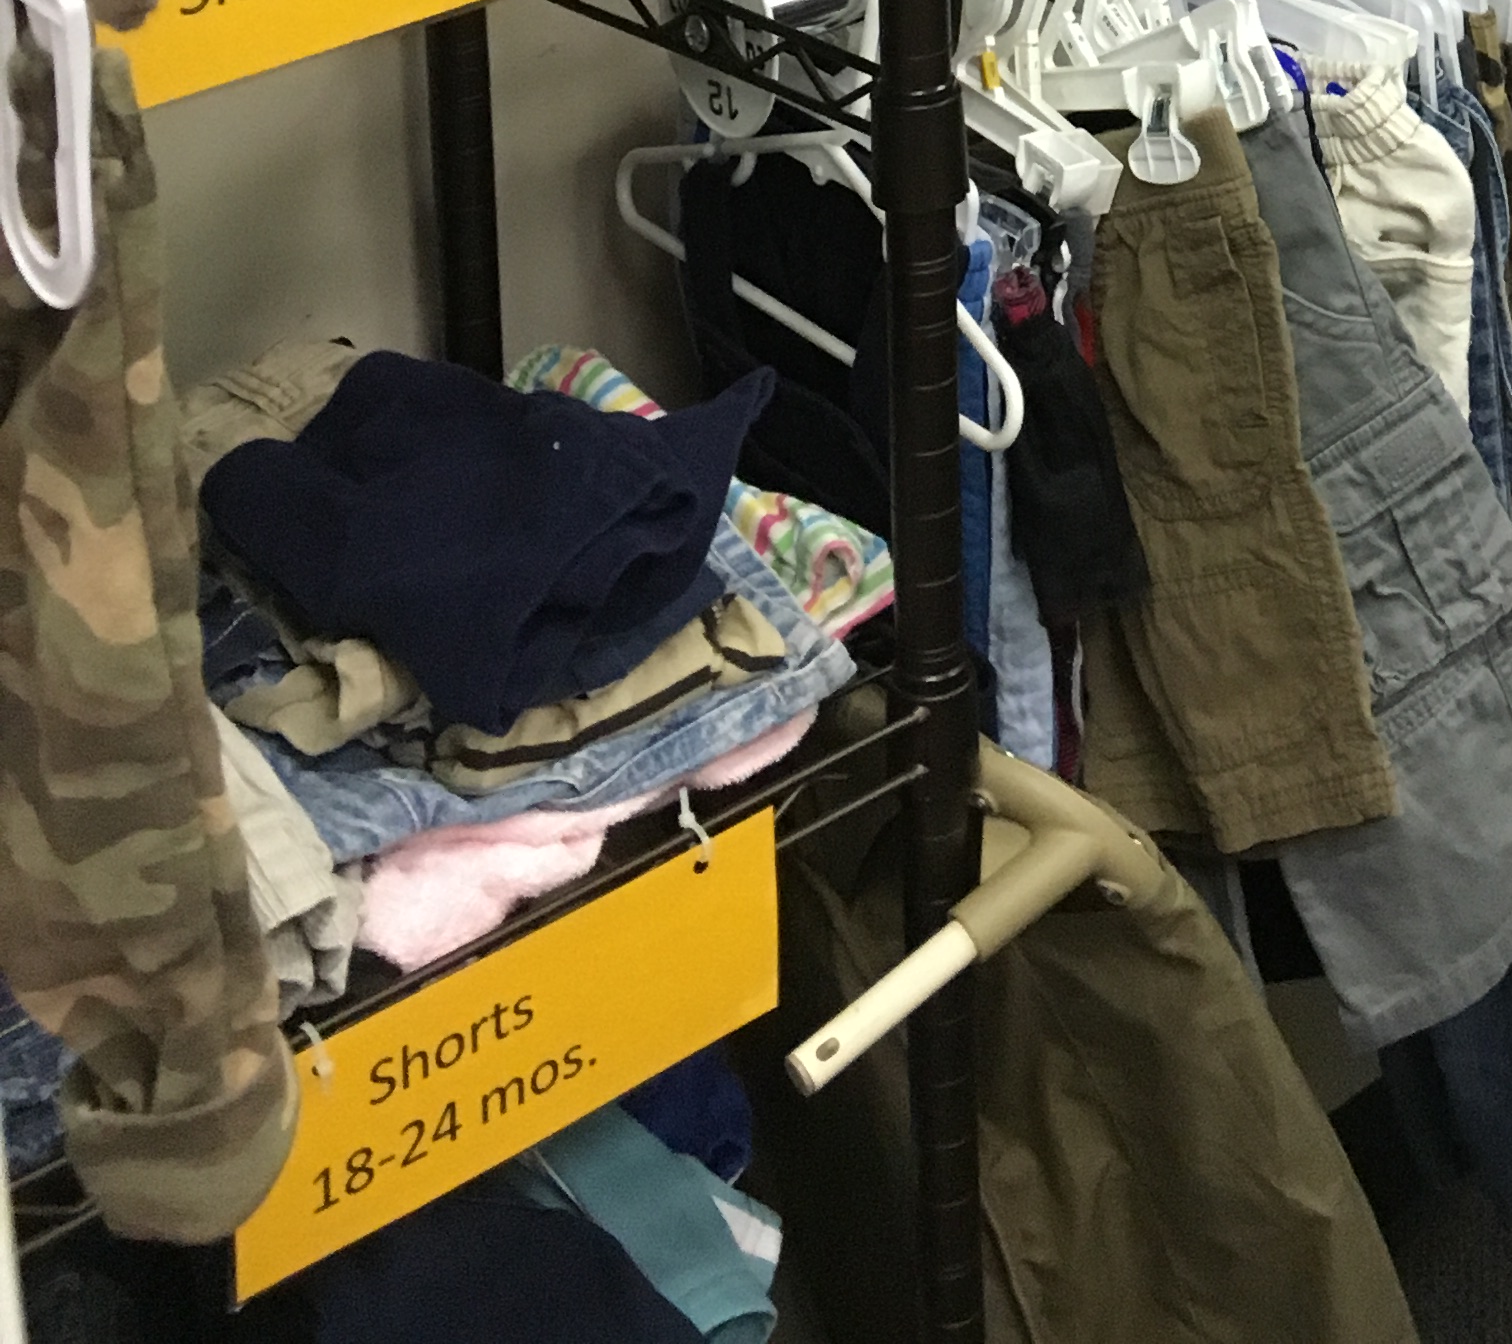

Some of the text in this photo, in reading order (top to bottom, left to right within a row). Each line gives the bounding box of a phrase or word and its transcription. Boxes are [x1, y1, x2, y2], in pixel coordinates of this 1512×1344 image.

[707, 78, 739, 121] 12
[367, 994, 536, 1106] Shorts
[311, 1041, 598, 1215] 18-24 mos.
